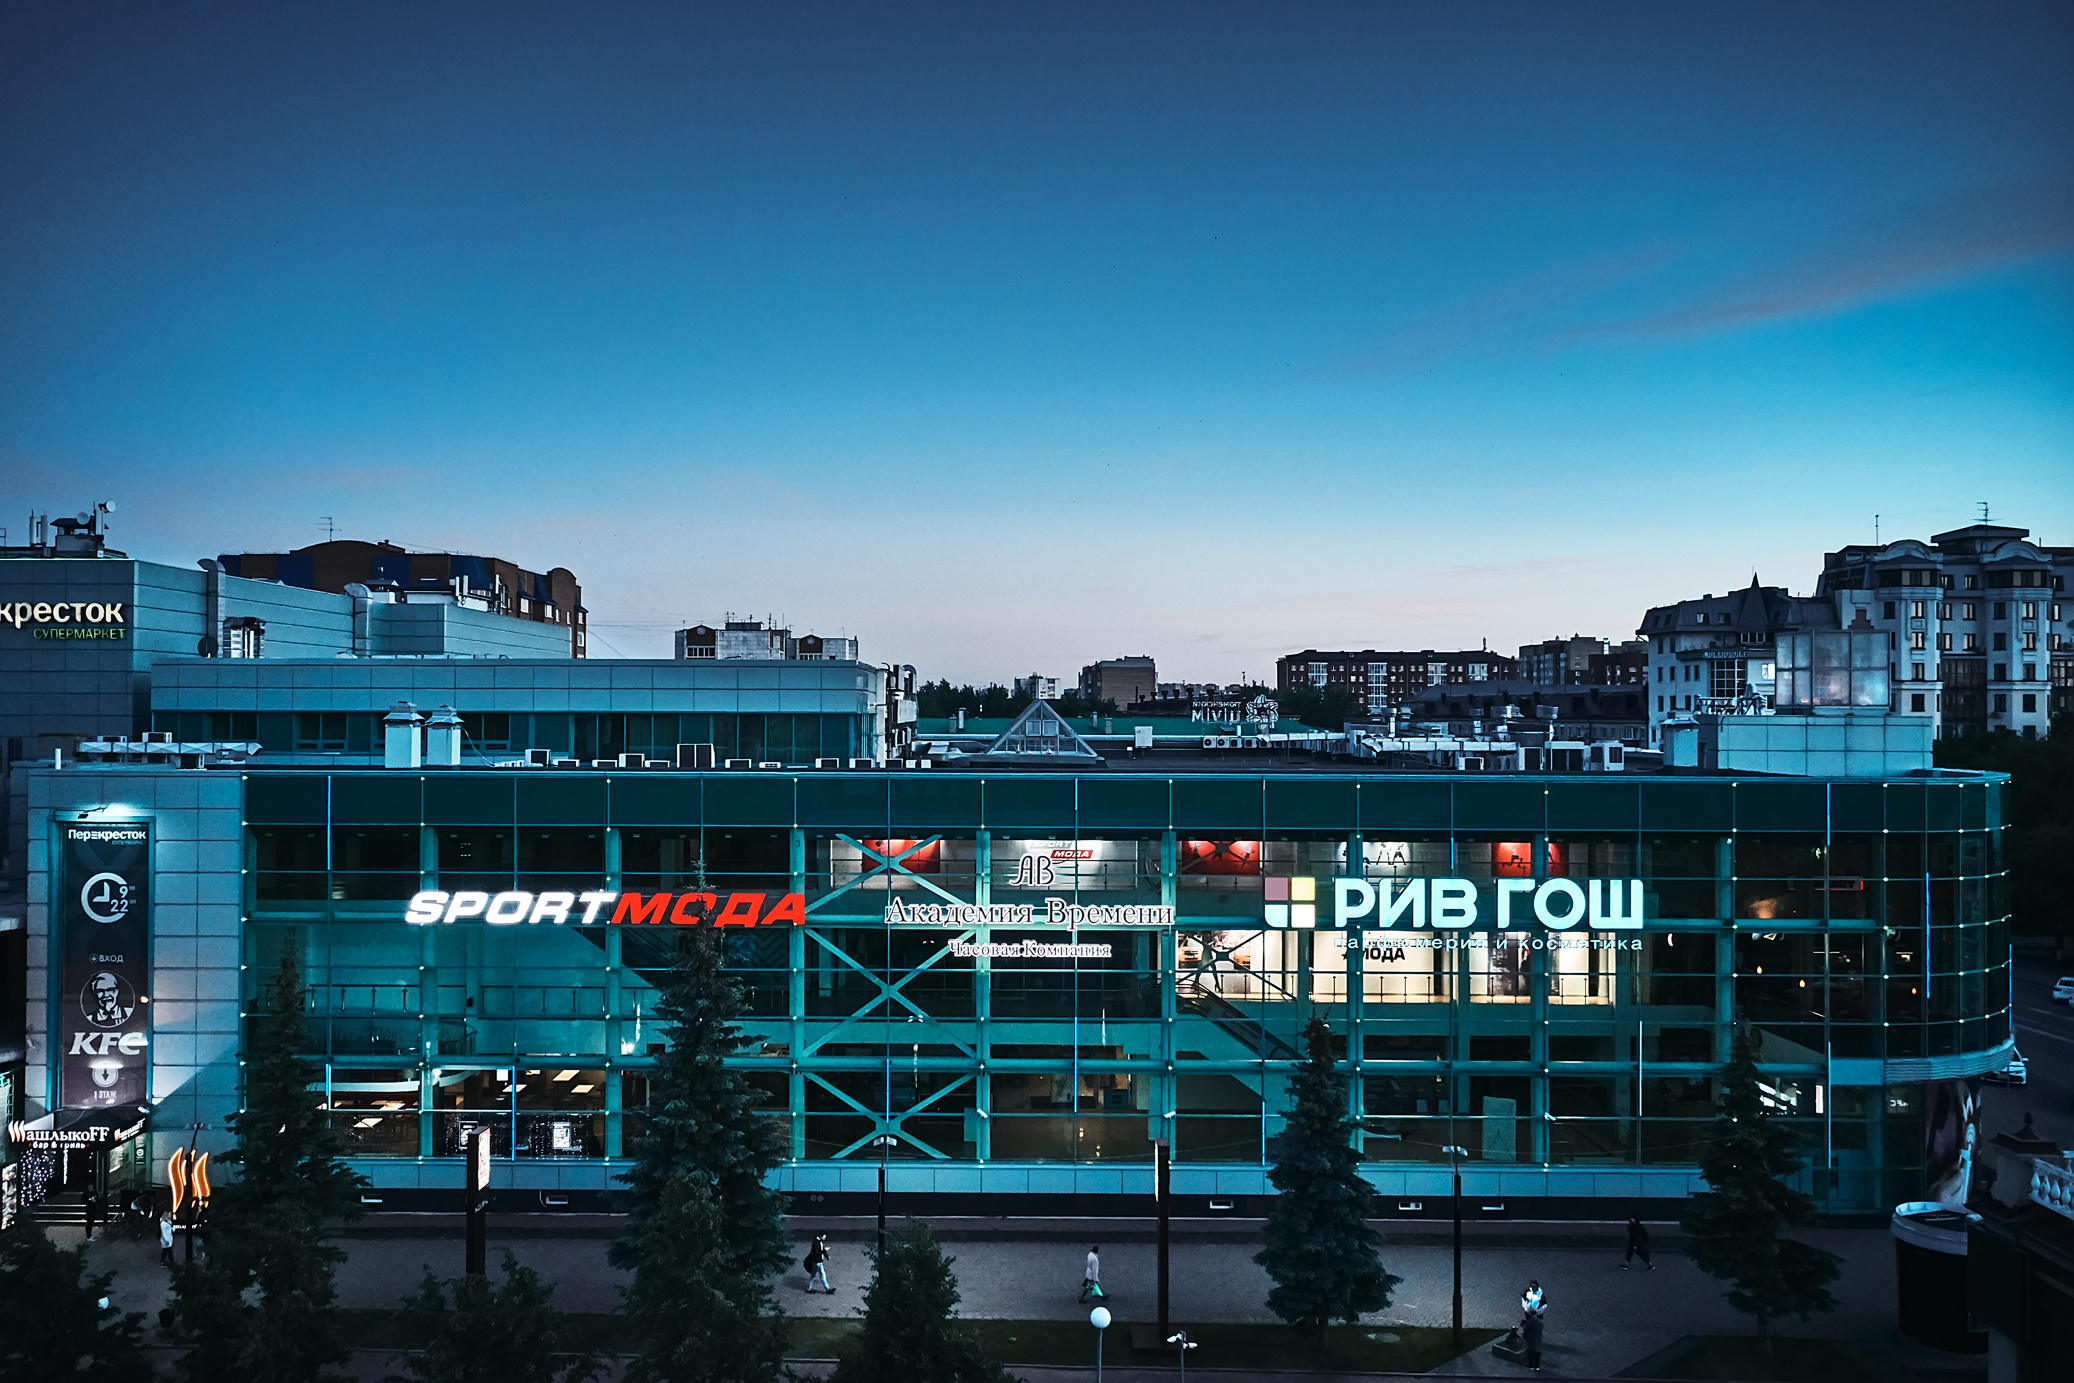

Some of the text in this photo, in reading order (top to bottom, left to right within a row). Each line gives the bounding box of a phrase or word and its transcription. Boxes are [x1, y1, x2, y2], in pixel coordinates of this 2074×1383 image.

[33, 628, 126, 640] СУПЕРМАРКЕТ
[1334, 878, 1644, 930] РИВ ГОШ
[885, 897, 1174, 931] Академия Времени
[949, 939, 1112, 958] Часовая Компания
[1334, 938, 1488, 952] парфюмерия
[1496, 938, 1508, 950] и
[1518, 938, 1643, 951] косметика
[99, 954, 124, 963] ВХОД
[68, 1032, 143, 1056] KFC
